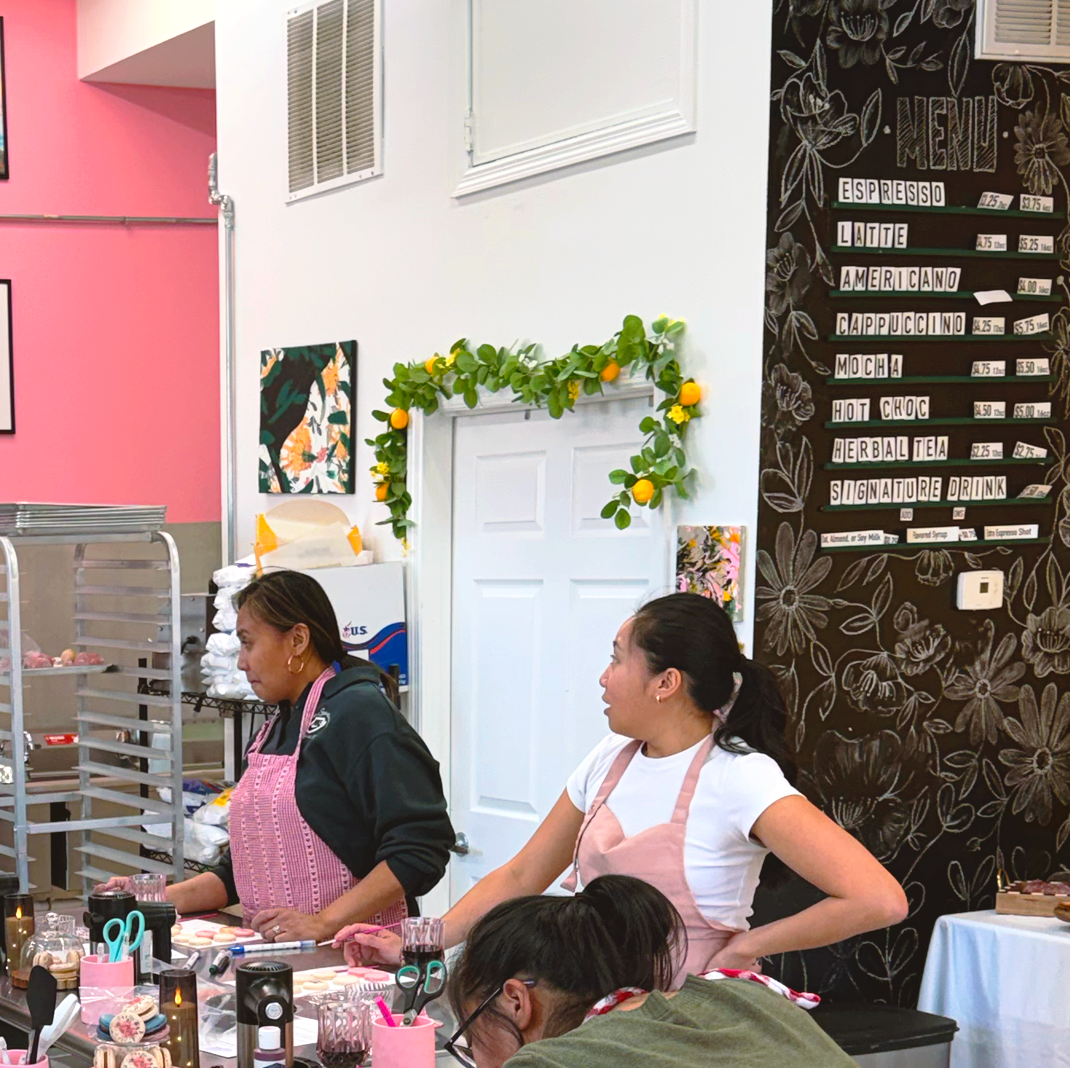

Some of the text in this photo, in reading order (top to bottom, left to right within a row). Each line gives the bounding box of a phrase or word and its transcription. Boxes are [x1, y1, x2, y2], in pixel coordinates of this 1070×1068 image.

[896, 96, 997, 172] MENU
[841, 180, 943, 203] ESPRESSO
[840, 224, 905, 245] LATTE
[842, 270, 958, 290] AMERICANO
[839, 314, 964, 334] CAPPUCCINO
[837, 356, 900, 376] MOCHA
[834, 398, 927, 420] HOT CHOC
[834, 437, 946, 460] HERBAL TEA
[831, 479, 940, 500] SIGNATURE
[949, 477, 1006, 499] DRINK
[857, 534, 867, 543] Soy
[1018, 528, 1032, 536] Shot
[350, 625, 368, 636] U.S.
